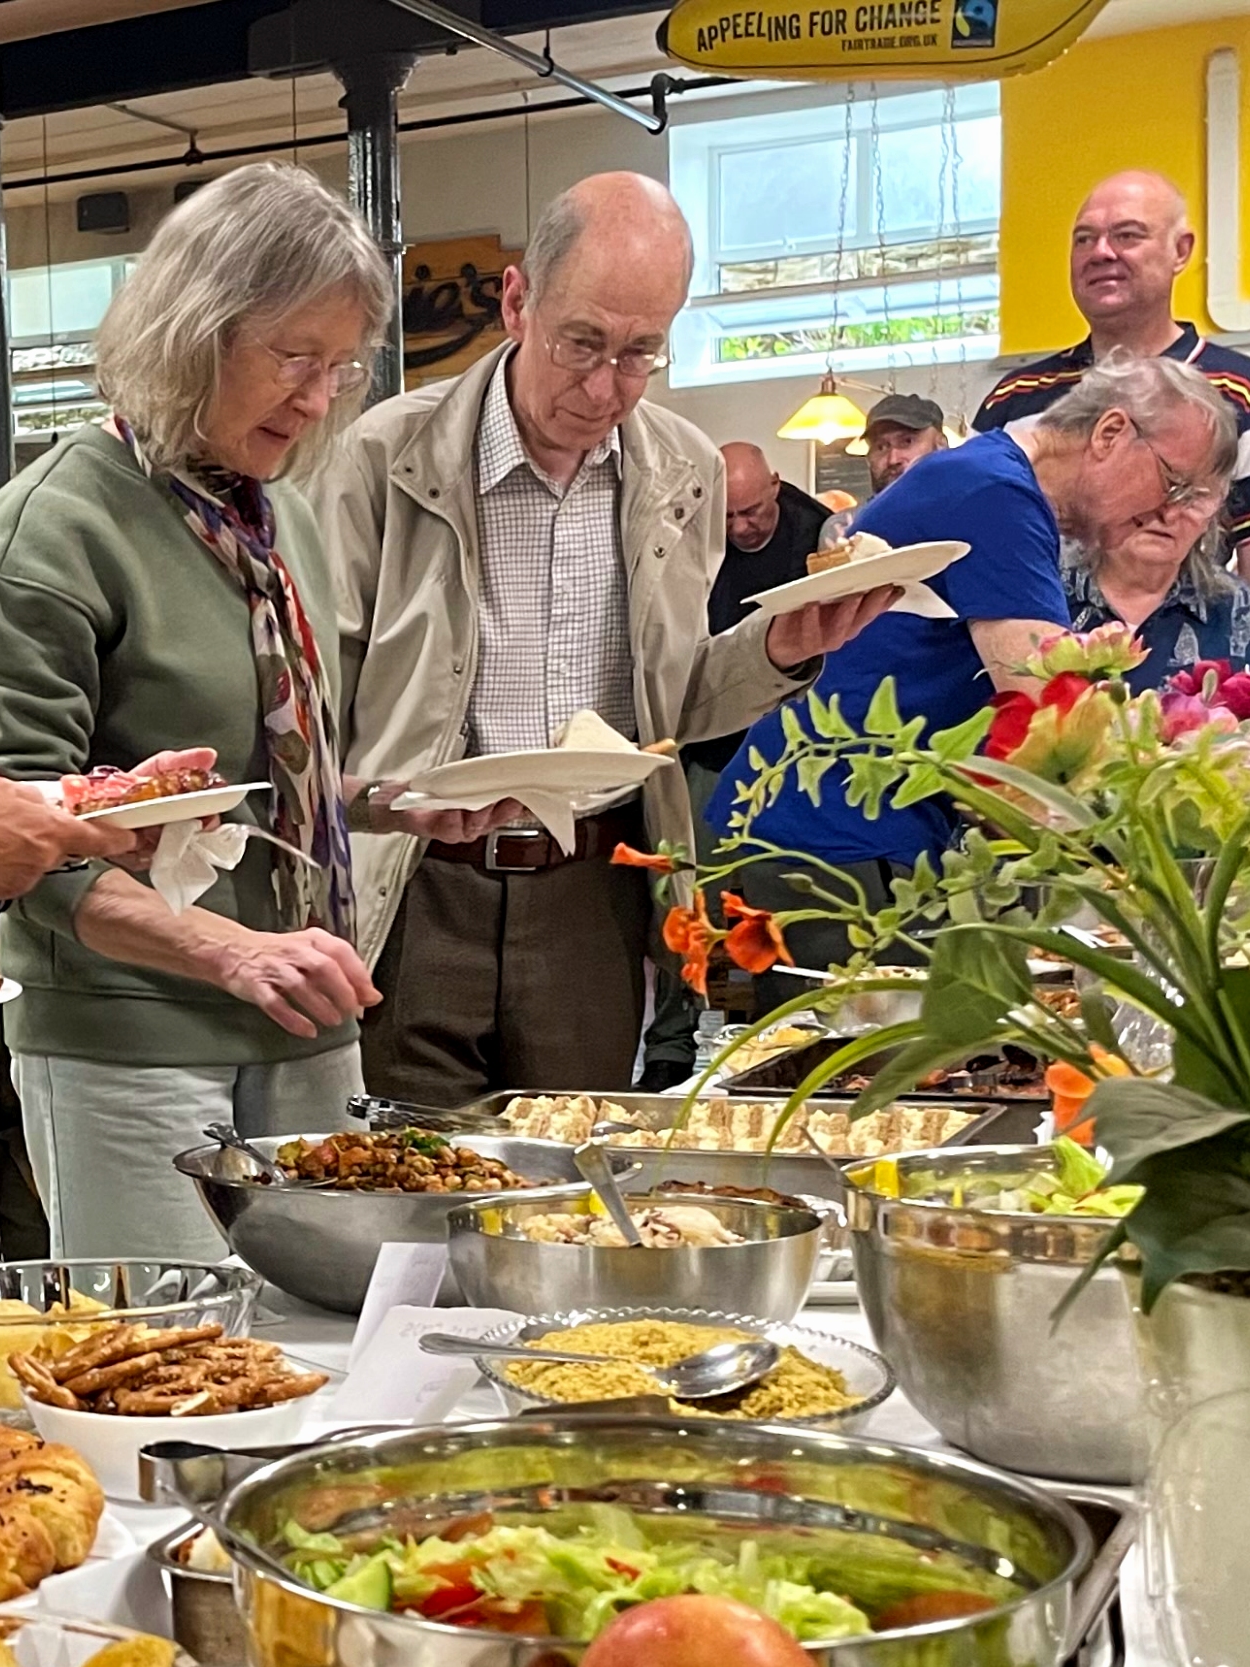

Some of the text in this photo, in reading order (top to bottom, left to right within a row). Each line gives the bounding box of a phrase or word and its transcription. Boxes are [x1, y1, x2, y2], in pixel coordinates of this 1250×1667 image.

[697, 0, 941, 52] APPEELING FOR CHANGE
